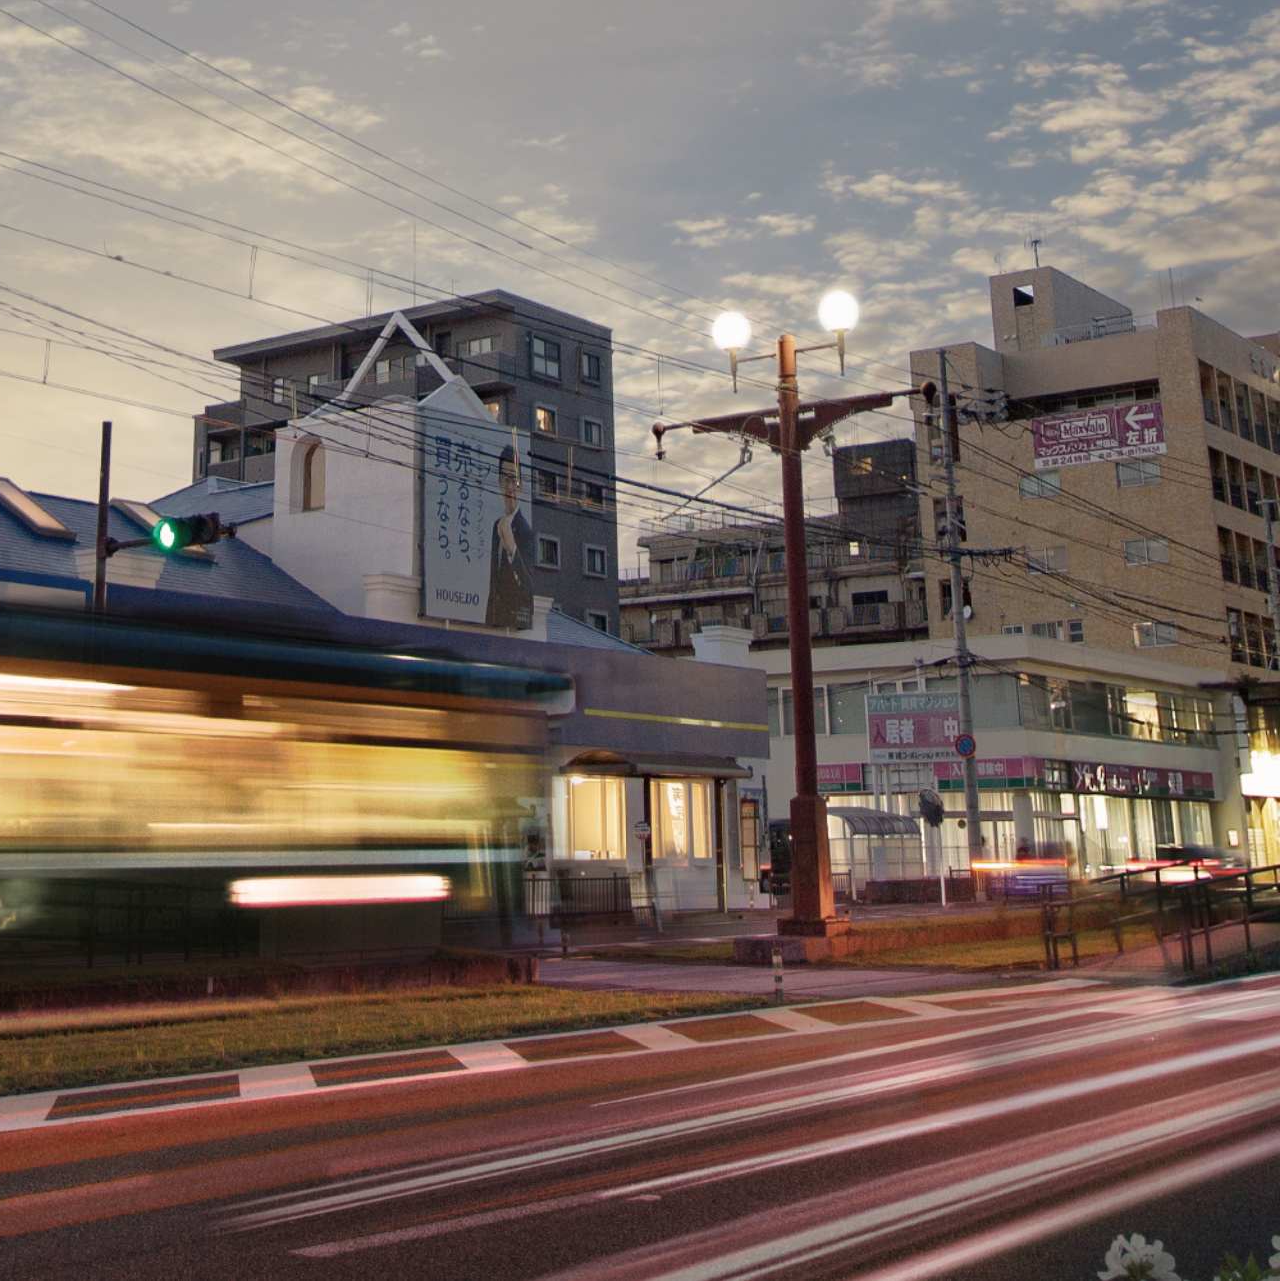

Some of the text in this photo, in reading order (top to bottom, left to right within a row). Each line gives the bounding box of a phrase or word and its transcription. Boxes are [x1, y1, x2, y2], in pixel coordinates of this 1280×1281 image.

[1063, 413, 1106, 436] MaxValu
[1125, 428, 1158, 445] 左折
[434, 435, 452, 560] 買うなら。
[455, 441, 472, 563] 売るなら、
[873, 716, 959, 744] 入居者中
